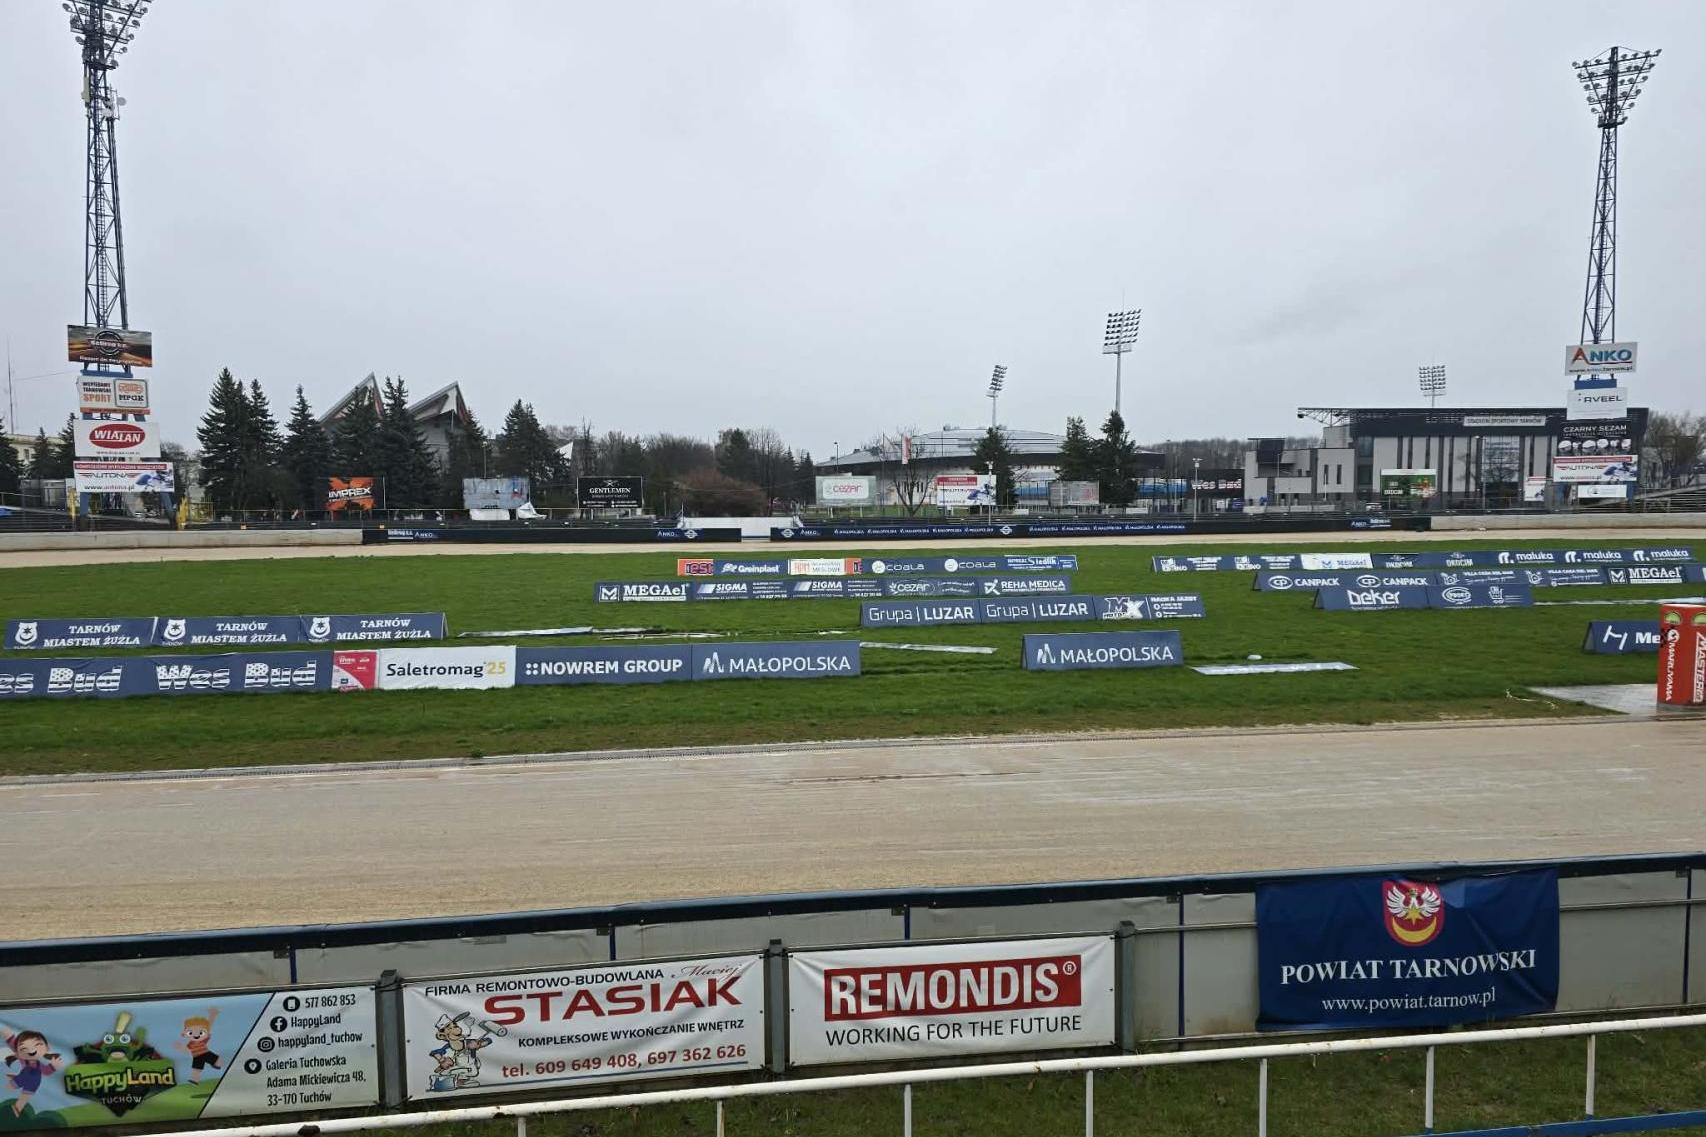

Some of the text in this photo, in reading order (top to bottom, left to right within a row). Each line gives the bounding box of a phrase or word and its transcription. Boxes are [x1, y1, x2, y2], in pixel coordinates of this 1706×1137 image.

[716, 583, 747, 591] SIGMA
[812, 581, 842, 589] SIGMA
[1001, 580, 1065, 589] REHA MEDICA
[1294, 578, 1340, 587] CANPACK
[1383, 577, 1429, 586] CANPACK
[869, 607, 974, 622] Grupa LUZAR
[986, 603, 1088, 618] Grupa LUZAR
[69, 624, 121, 634] TARNÓW
[216, 621, 268, 632] TARNÓW
[360, 618, 411, 628] TARNÓW
[43, 638, 101, 647] MIASTEM
[191, 634, 248, 644] MIASTEM
[336, 631, 392, 640] MIASTEM
[1060, 646, 1174, 664] MAŁOPOLSKA
[386, 662, 484, 677] Saletromag
[540, 659, 683, 675] NOWREM GROUP
[729, 655, 851, 673] MAŁOPOLSKA
[47, 665, 123, 693] Bud
[156, 664, 231, 690] Wes
[244, 660, 317, 688] Bud
[1280, 949, 1537, 985] POWIAT TARNOWSKI
[425, 969, 664, 997] FIRMA REMONTOWO-BUDOWLANA
[305, 994, 356, 1008] 577 862 853
[484, 976, 743, 1026] STASIAK
[1321, 987, 1497, 1013] www.powiat.tarnow.pl
[291, 1013, 341, 1029] HappyLand
[518, 1019, 744, 1048] KOMPLEKSOWE WYKOŃCZANIE WNĘTRZ
[826, 1014, 1082, 1046] WORKING FOR THE FUTURE
[278, 1032, 362, 1048] happyland_tuchow
[266, 1055, 347, 1071] Galeria Tuchowska
[501, 1043, 747, 1078] tel. 609 649 408, 697 362 626
[66, 1068, 174, 1093] HappyLand
[267, 1077, 297, 1088] Adama
[300, 1072, 350, 1086] Mickiewicza
[102, 1094, 142, 1104] TUCHÓW
[267, 1090, 332, 1106] 33-170 Tuchów
